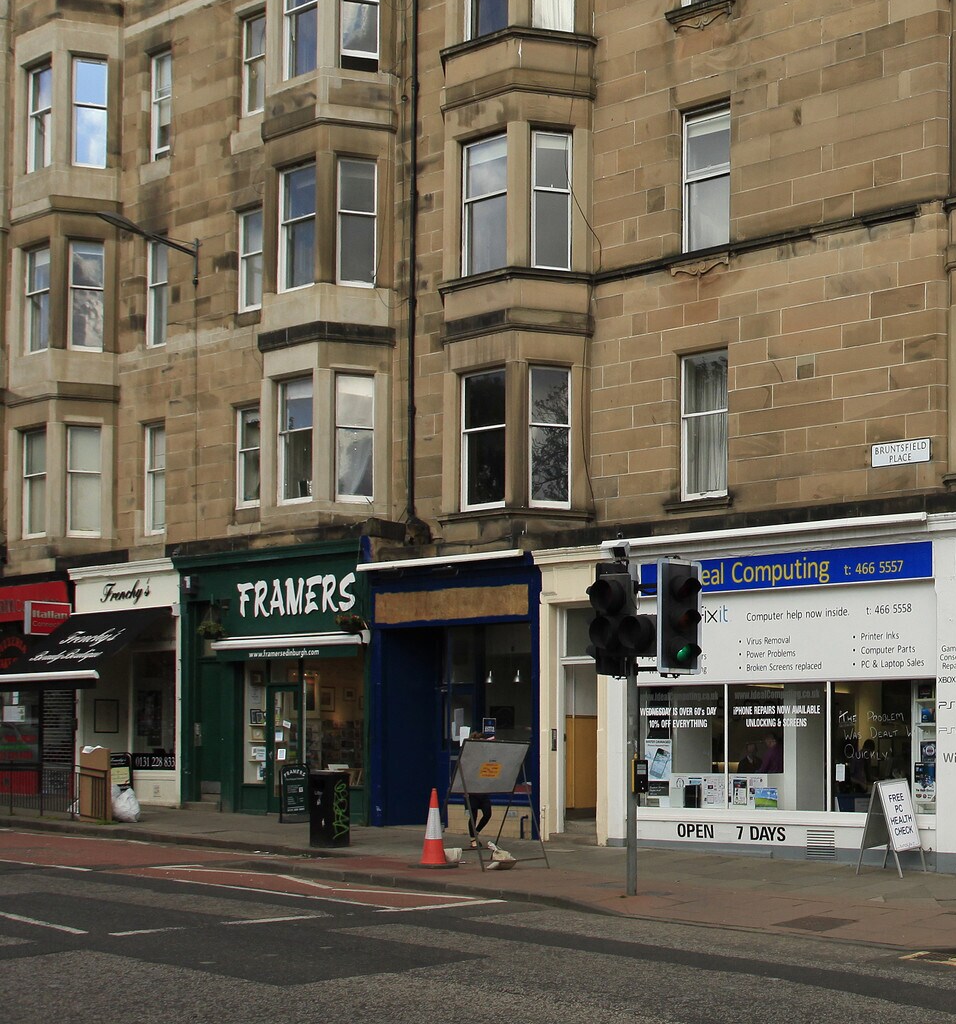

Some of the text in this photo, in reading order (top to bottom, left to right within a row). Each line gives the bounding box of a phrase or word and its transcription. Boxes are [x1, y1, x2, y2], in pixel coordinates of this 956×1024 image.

[874, 441, 927, 455] BRUNTSFIELD
[889, 453, 912, 463] PLACE
[702, 562, 724, 585] eal
[731, 557, 830, 586] Computing
[855, 562, 875, 575] 466
[879, 560, 904, 574] 5557
[100, 578, 151, 605] Frenchy's
[237, 572, 356, 618] FRAMERS
[32, 609, 68, 620] Italian
[874, 605, 890, 615] 466
[893, 603, 912, 614] 5558
[746, 607, 850, 623] Computer help now inside.
[746, 635, 791, 646] Virus Removal
[860, 631, 900, 641] Printer Inks
[249, 648, 320, 658] www.framersedinburgh.com
[746, 649, 796, 658] Power Problems
[860, 644, 916, 656] Computer Parts
[746, 661, 822, 672] Broken Screens replaced
[860, 657, 925, 670] PC & Laptop Sales
[640, 707, 671, 716] WEDNESDAY
[672, 707, 678, 716] IS
[679, 707, 693, 716] OVER
[706, 706, 717, 716] DAY
[753, 705, 776, 715] REPAIRS
[776, 705, 791, 714] NOW
[792, 704, 821, 714] AVAILABLE
[649, 719, 708, 728] 10% OFF EVERYTHING
[745, 718, 807, 727] UNLOCKING & SCREENS
[870, 726, 898, 739] DEALT
[135, 757, 150, 767] 0131
[151, 757, 163, 767] 228
[888, 792, 905, 803] FREE
[894, 804, 904, 813] PC
[890, 814, 913, 826] HEALTH
[677, 823, 786, 842] OPEN 7 DAYS
[894, 825, 914, 837] CHECK
